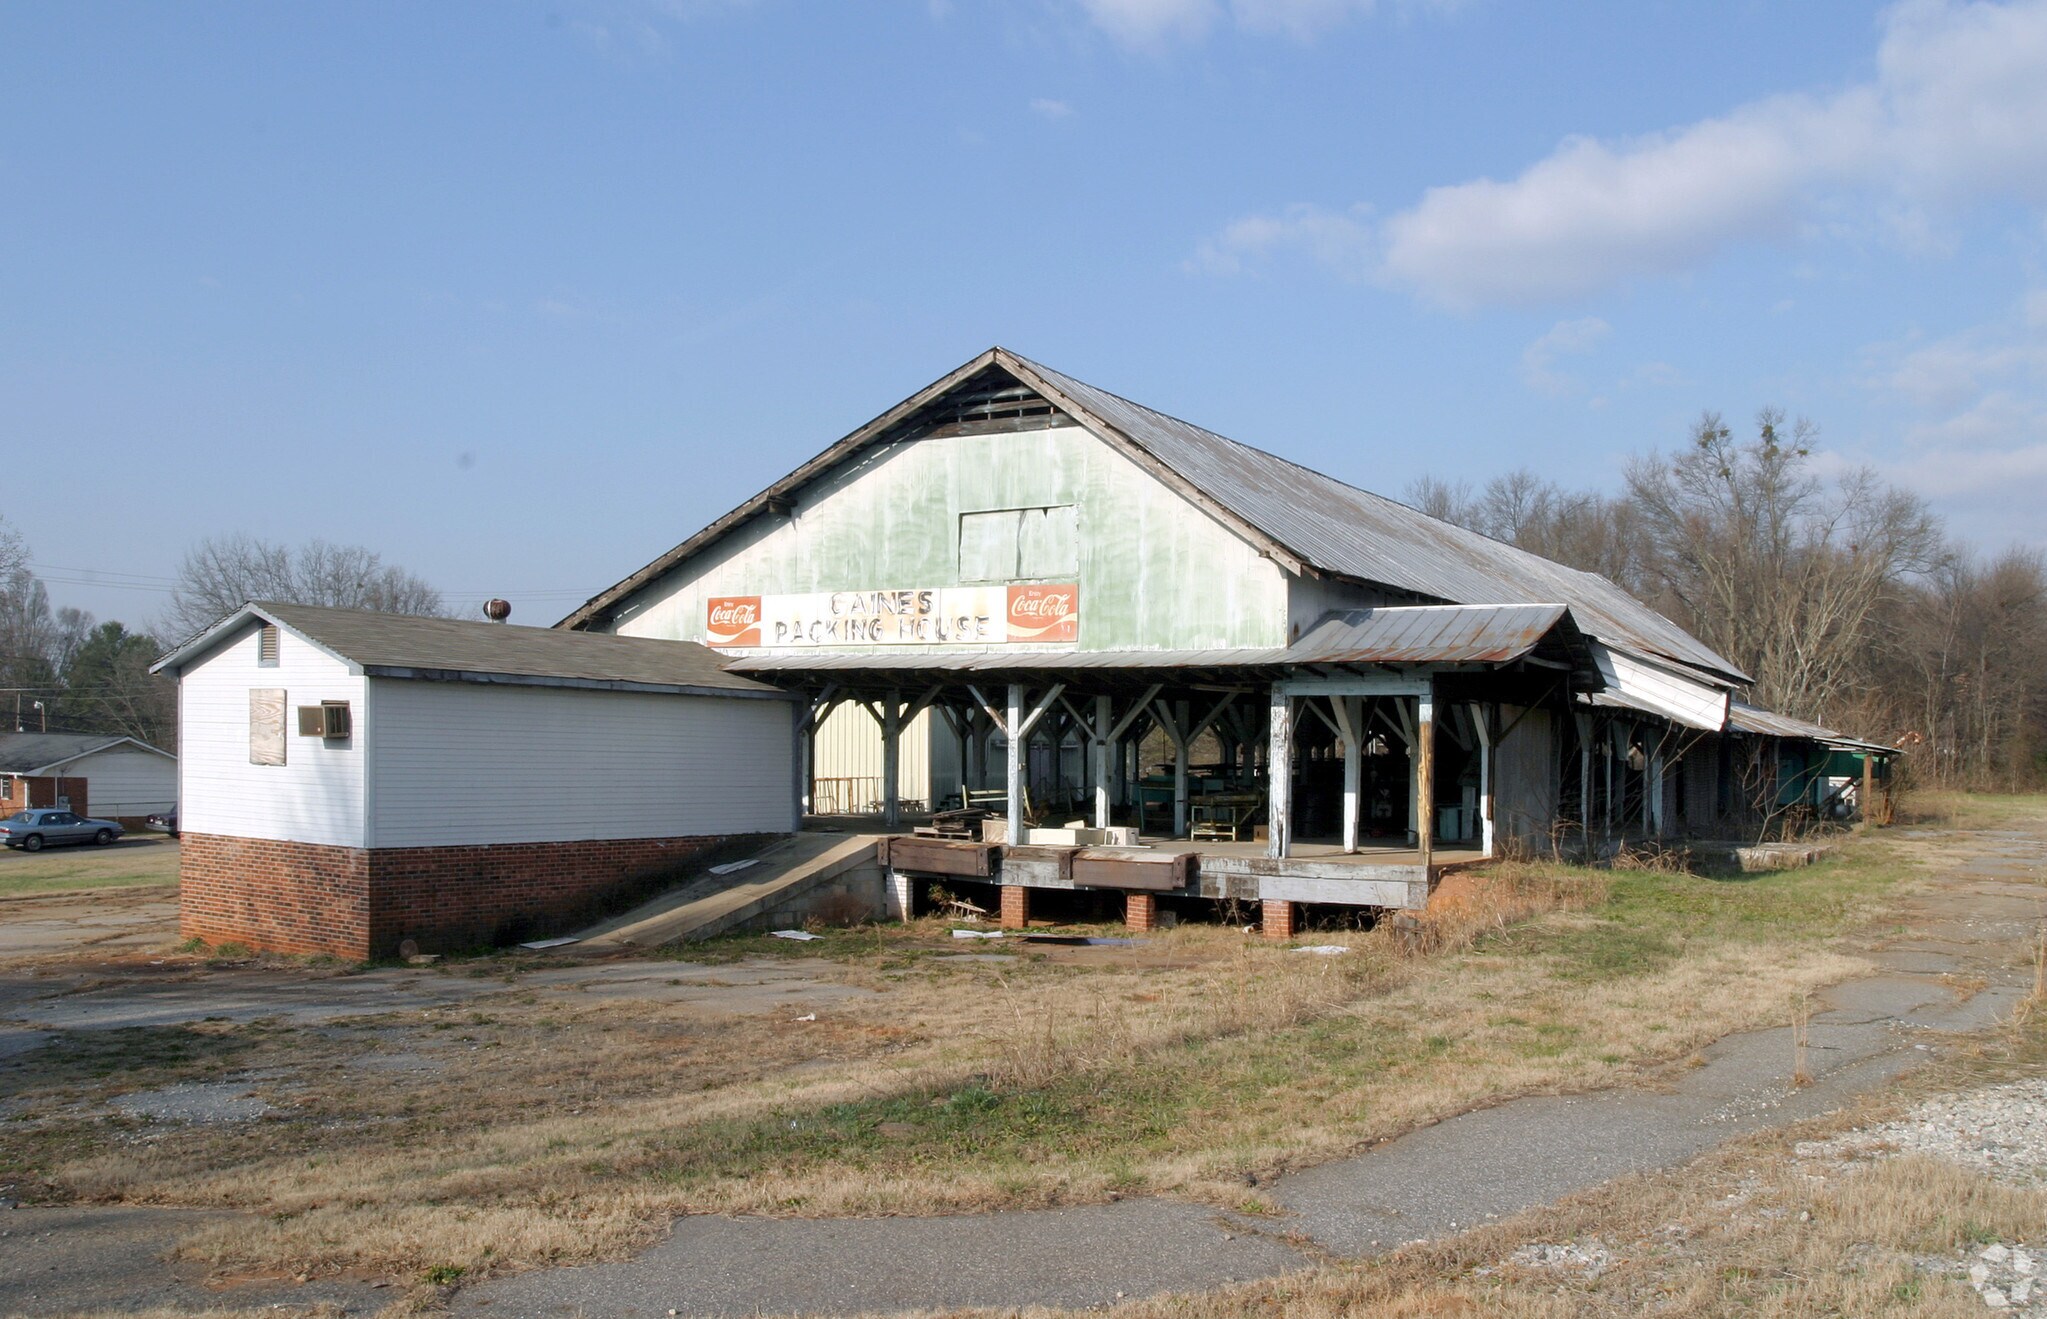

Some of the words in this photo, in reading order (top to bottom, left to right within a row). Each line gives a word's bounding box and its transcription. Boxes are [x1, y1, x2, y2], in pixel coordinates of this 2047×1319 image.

[710, 604, 756, 625] Coca-Cola
[1011, 594, 1071, 617] Coca-Cola
[775, 618, 883, 643] PACKING
[898, 616, 990, 641] HOUSE
